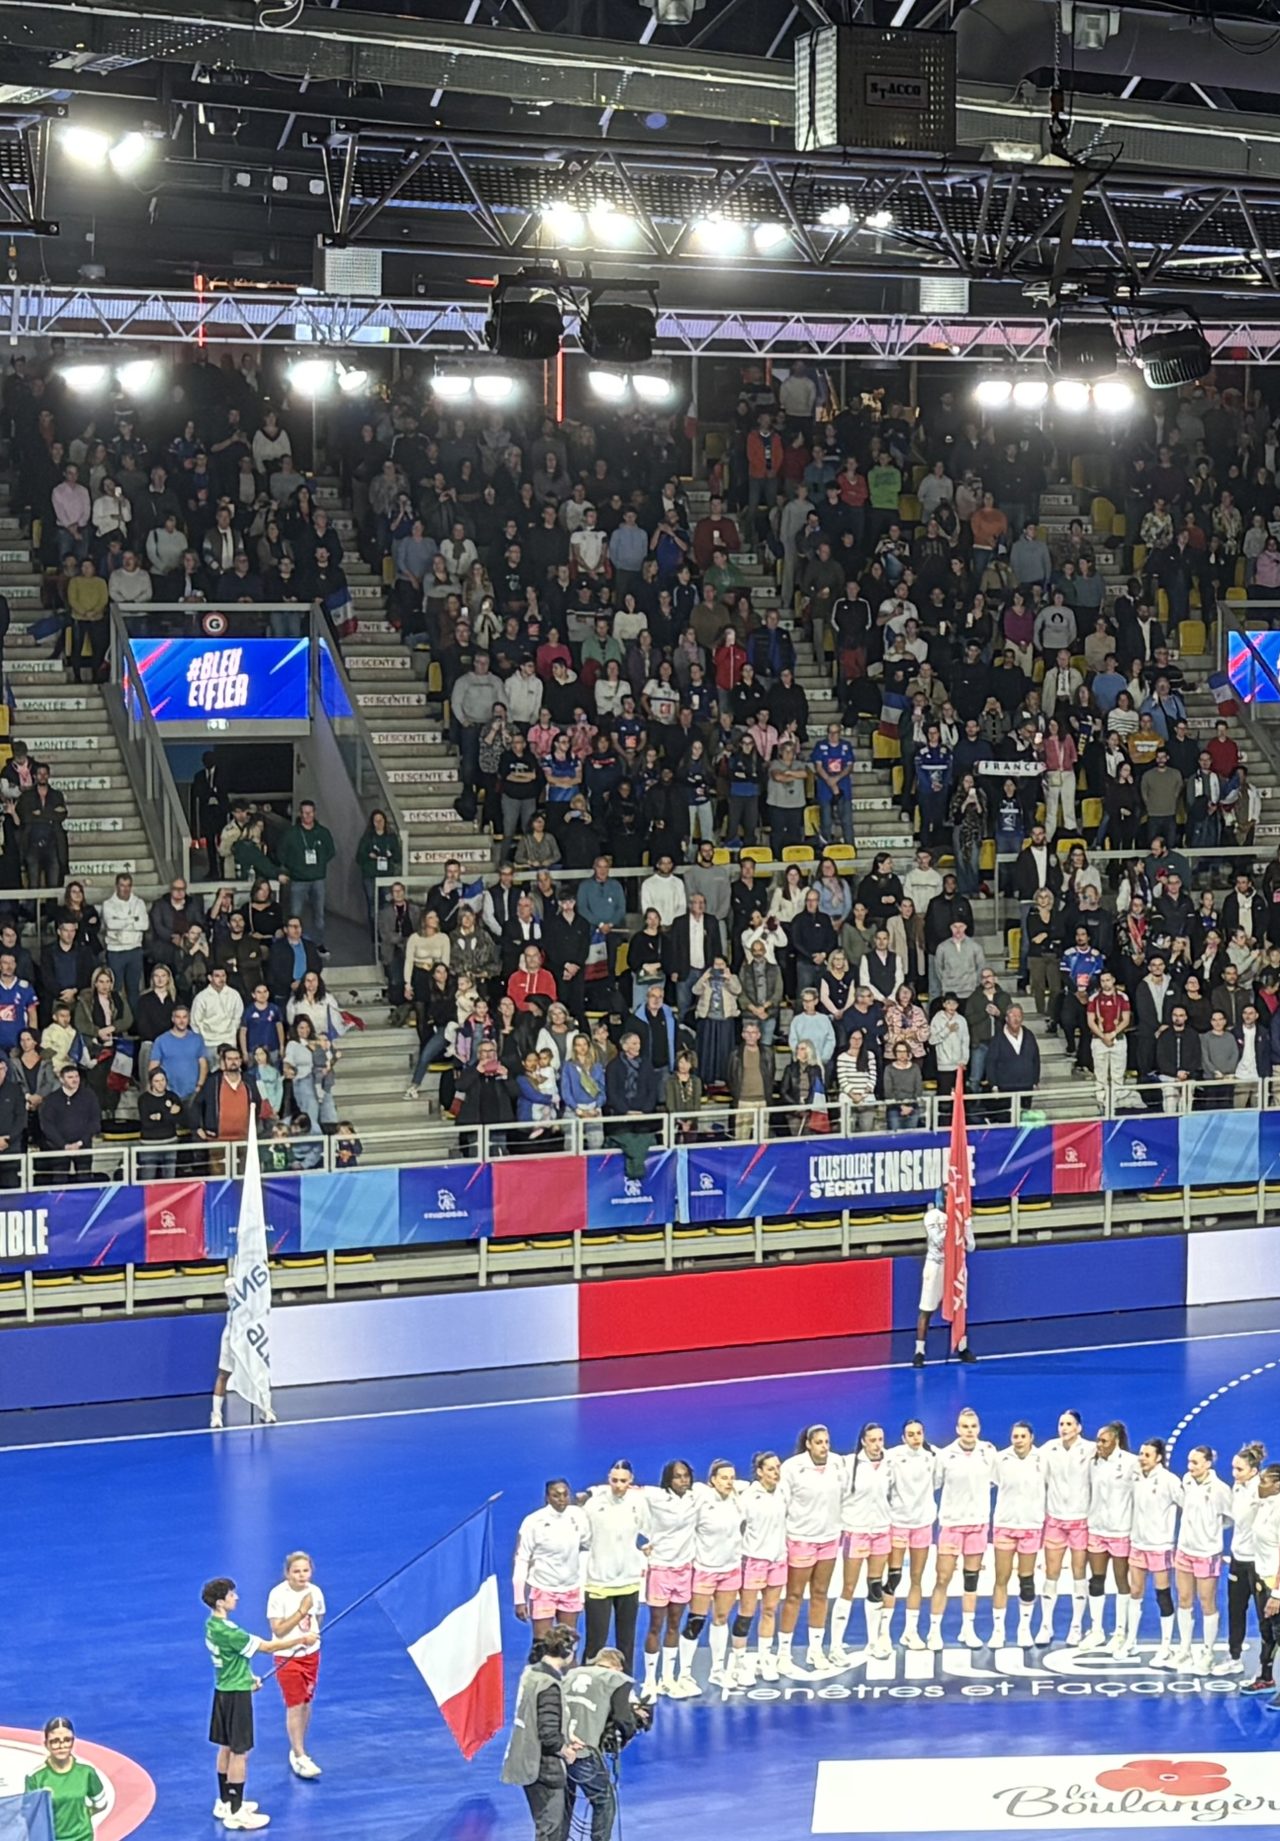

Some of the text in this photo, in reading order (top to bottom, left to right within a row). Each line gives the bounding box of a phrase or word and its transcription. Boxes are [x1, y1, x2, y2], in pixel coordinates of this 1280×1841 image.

[208, 618, 221, 630] G
[186, 646, 242, 682] #BLEU
[377, 734, 427, 743] DESCENTE
[984, 762, 1038, 771] FRANCE
[393, 773, 443, 782] DESCENTE
[425, 851, 475, 861] DESCENTE
[809, 1152, 873, 1182] L'HISTOIRE
[874, 1146, 976, 1194] ENSEME
[961, 1680, 1015, 1698] et
[1066, 1783, 1097, 1801] la
